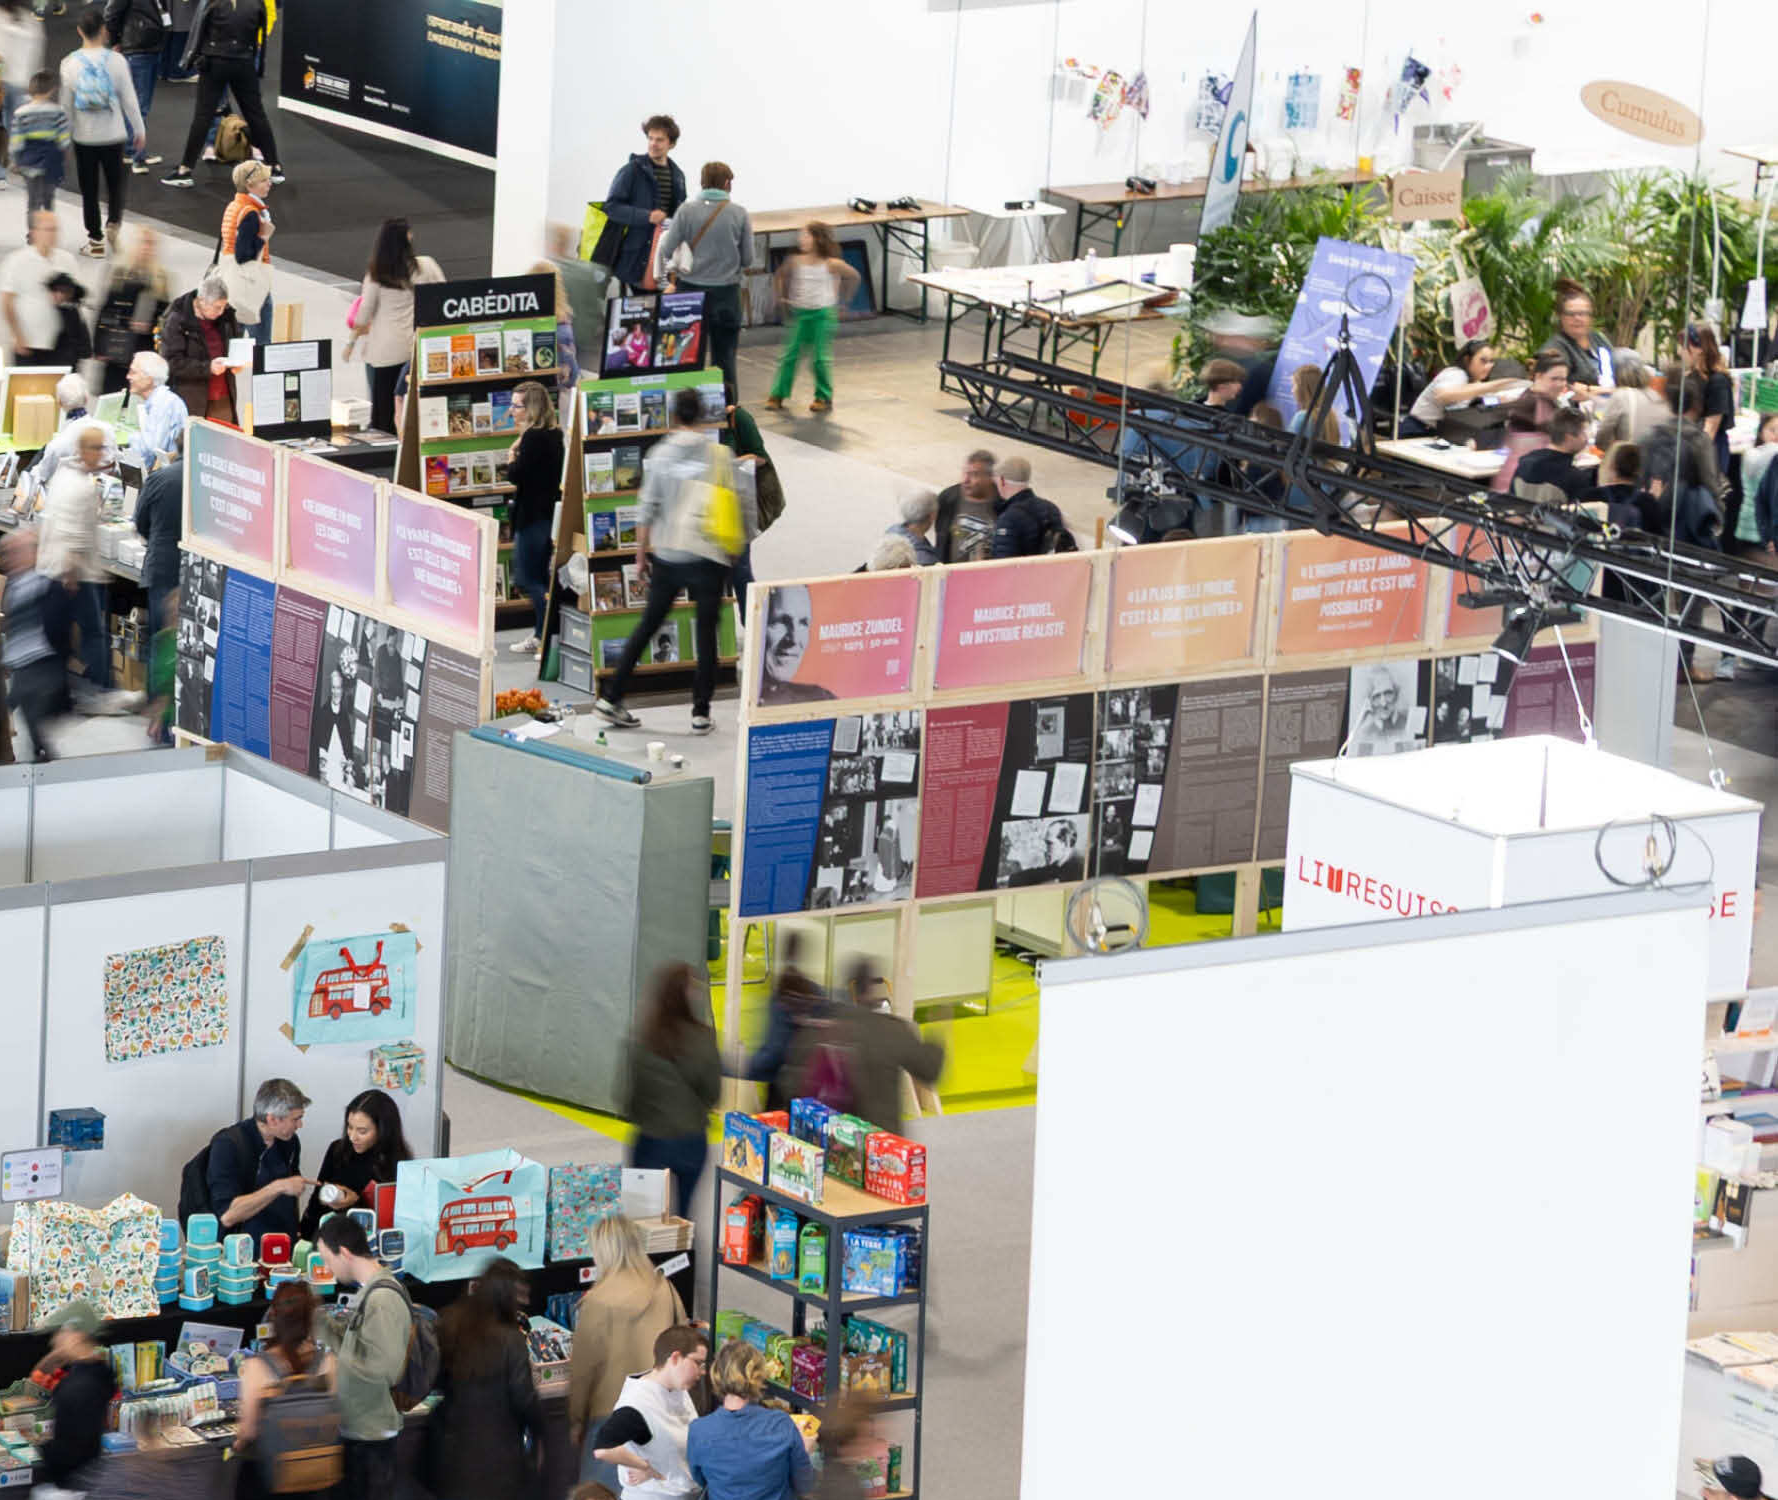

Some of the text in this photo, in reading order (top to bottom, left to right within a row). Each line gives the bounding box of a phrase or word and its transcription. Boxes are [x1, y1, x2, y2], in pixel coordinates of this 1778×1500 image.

[1599, 89, 1686, 138] Cumulus
[1398, 184, 1457, 208] Caisse
[443, 289, 540, 318] CABÉDITA
[974, 605, 1016, 624] MAURICE
[819, 620, 864, 641] MAURICE
[959, 630, 972, 646] UN
[974, 626, 1021, 645] MYSTIQUE
[1298, 855, 1459, 918] LIVRESUIS
[850, 1237, 883, 1251] LA TERRE
